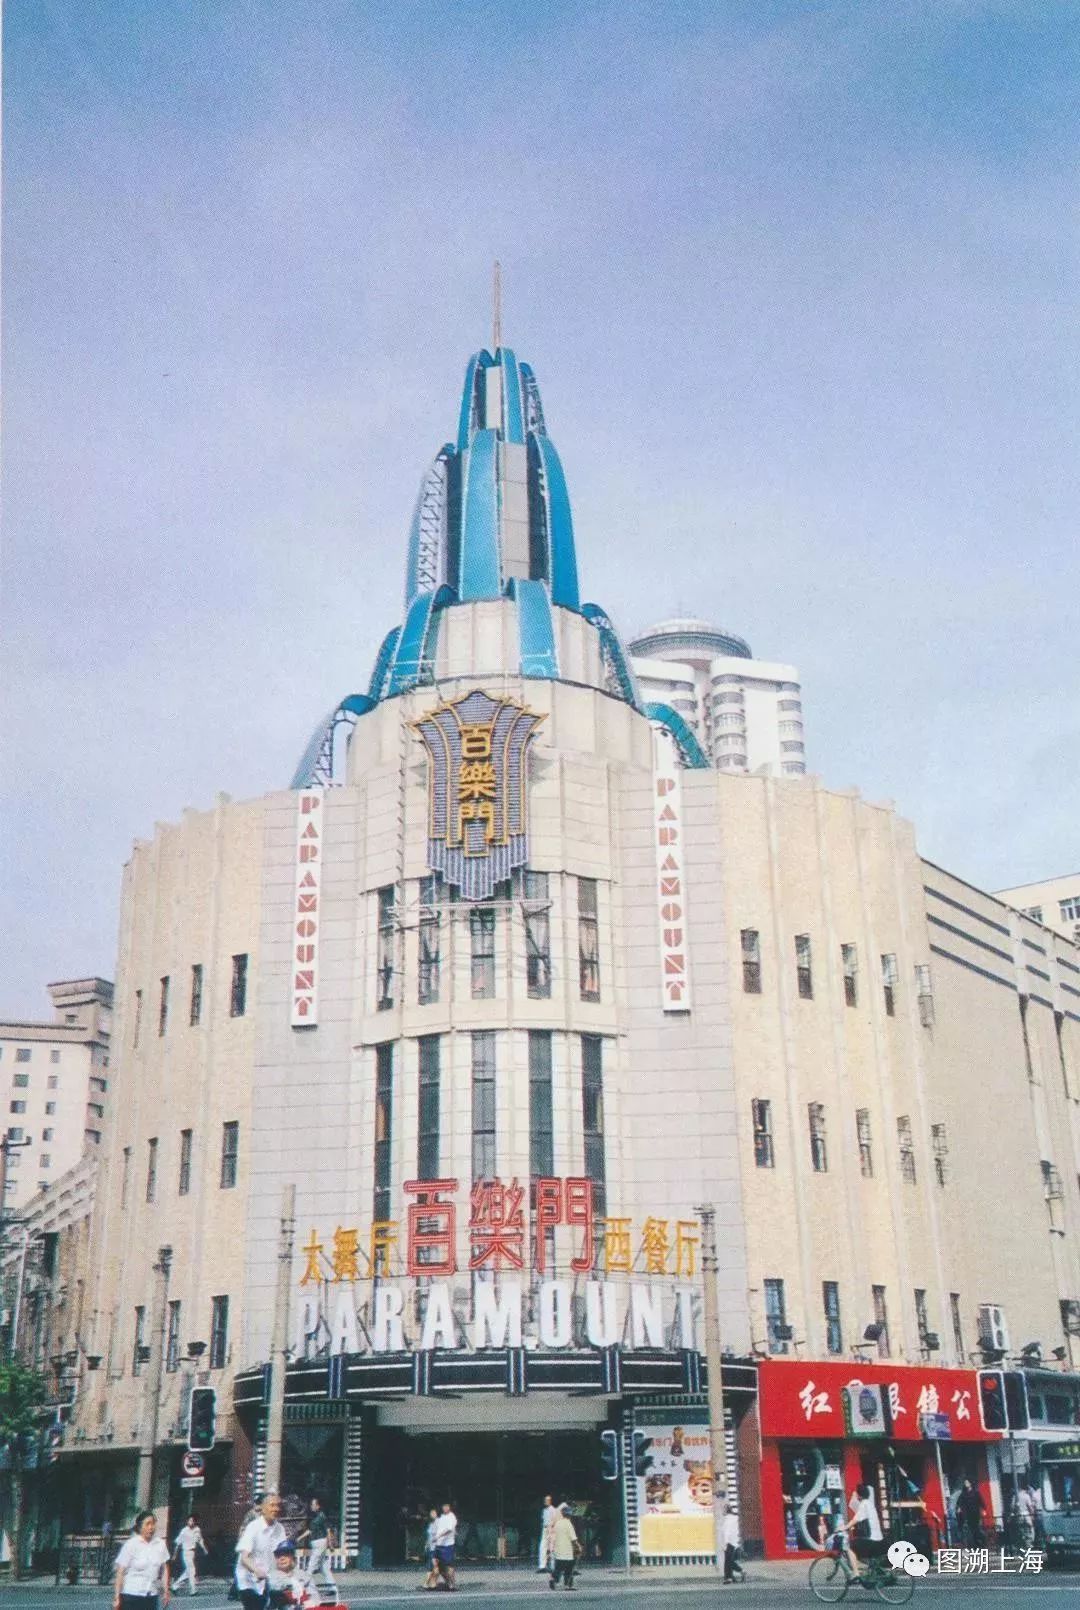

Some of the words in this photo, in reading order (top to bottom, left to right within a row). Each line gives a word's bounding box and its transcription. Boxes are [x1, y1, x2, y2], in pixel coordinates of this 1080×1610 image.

[458, 724, 496, 845] 百樂門
[294, 795, 321, 1017] PARAMOUNT
[656, 778, 685, 1001] PARAMOUNT
[403, 1176, 593, 1277] 百樂門
[603, 1216, 699, 1278] 西餐厅
[297, 1280, 703, 1359] PARAMOUNT
